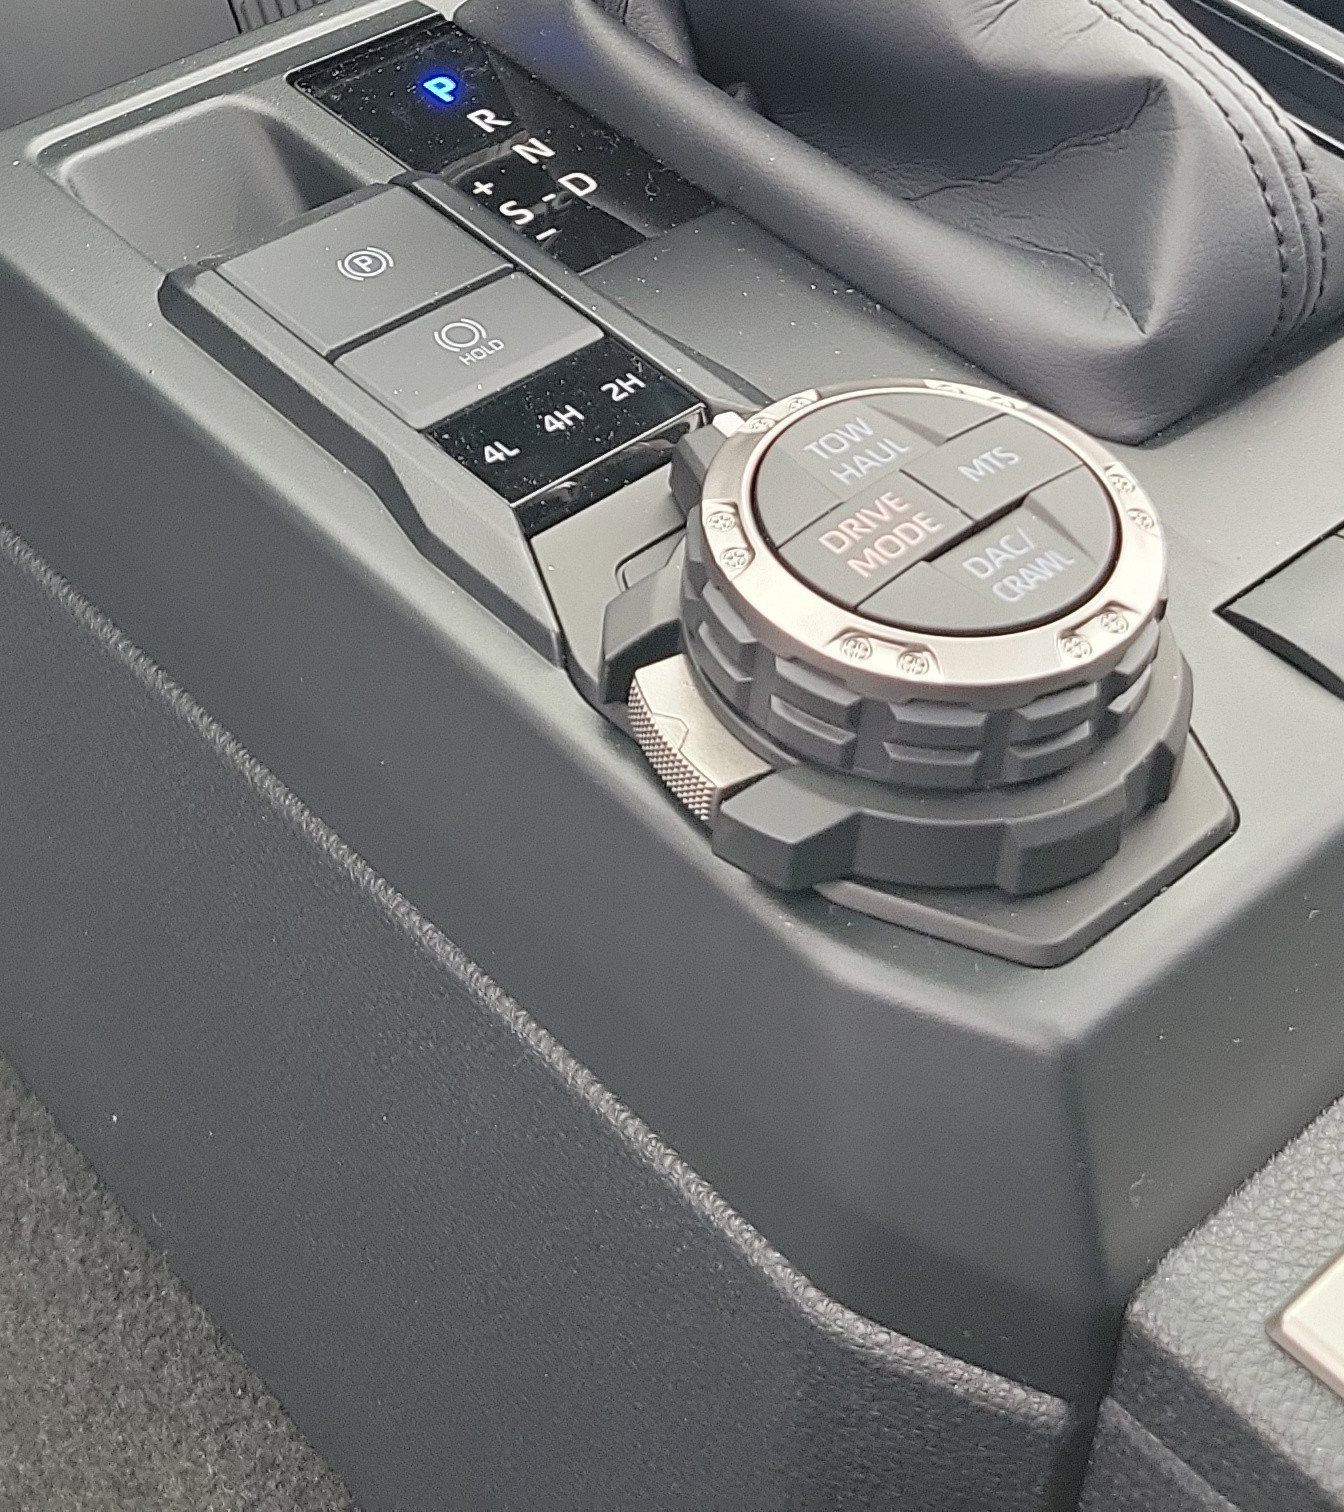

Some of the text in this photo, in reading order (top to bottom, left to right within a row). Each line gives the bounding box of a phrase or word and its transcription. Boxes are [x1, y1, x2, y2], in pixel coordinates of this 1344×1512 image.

[422, 74, 458, 104] P
[466, 107, 513, 133] R
[511, 136, 556, 164] N
[557, 172, 599, 197] D
[498, 199, 535, 227] S
[458, 338, 506, 367] HOLD
[600, 372, 646, 403] 2H
[542, 404, 585, 435] 4H
[482, 439, 520, 465] 4L
[803, 417, 874, 459] TOW
[828, 439, 910, 487] HAUL
[957, 444, 1021, 483] MTS
[817, 489, 912, 556] DRIVE
[846, 509, 945, 579] MODE
[961, 524, 1035, 581] DAC/
[991, 552, 1077, 605] CRAWL
